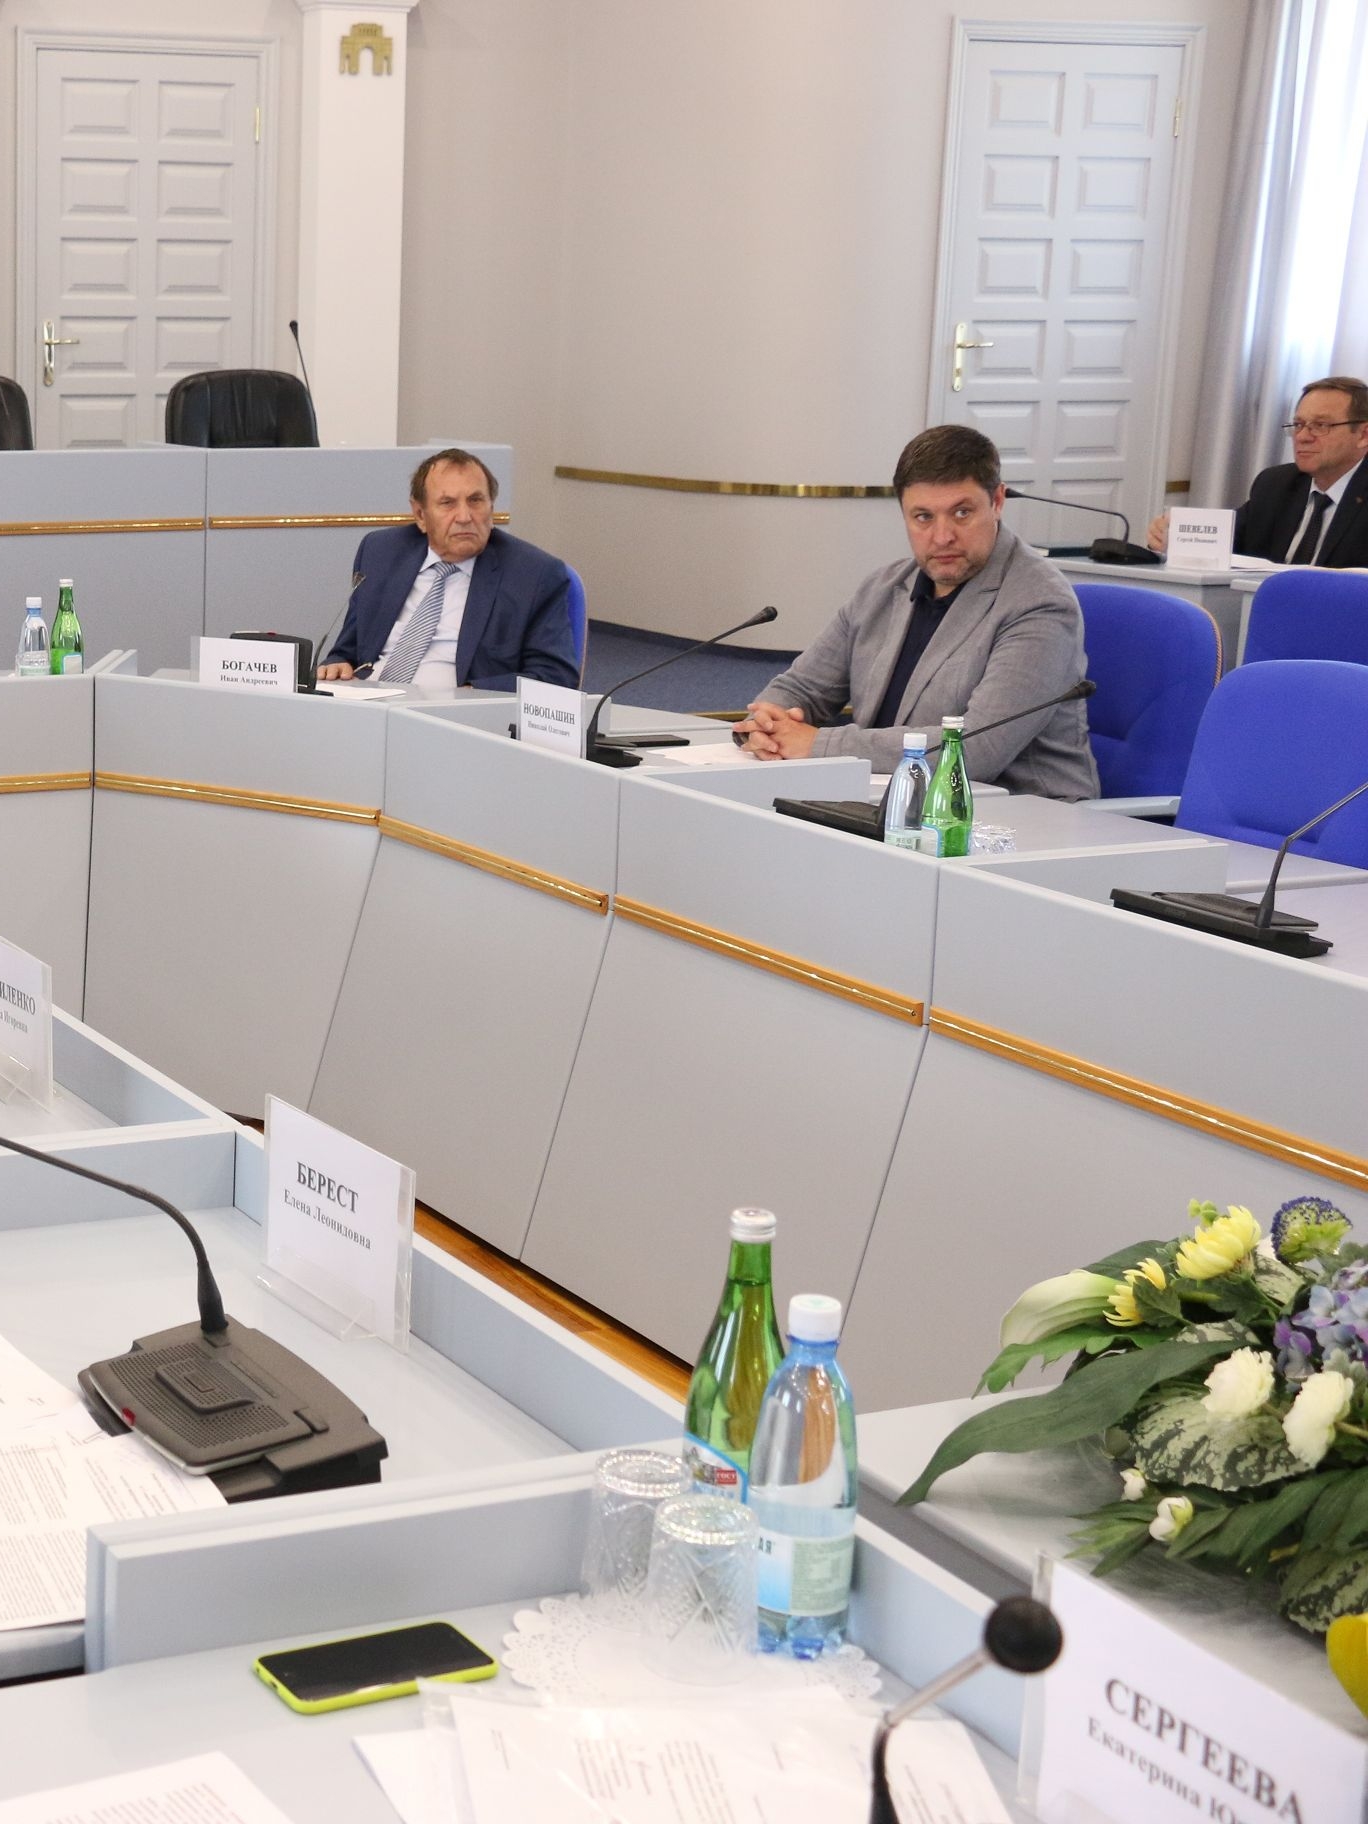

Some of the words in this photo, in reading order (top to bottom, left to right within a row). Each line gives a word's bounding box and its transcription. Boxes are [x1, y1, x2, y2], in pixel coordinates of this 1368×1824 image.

[220, 674, 239, 683] Иван
[240, 675, 278, 686] Андреевич
[222, 660, 278, 674] БОГАЧЕВ
[523, 702, 576, 725] НОВОПАШИН
[296, 1161, 359, 1214] БЕРЕСТ
[283, 1188, 311, 1217] Елена
[313, 1208, 372, 1250] Леонидовна
[1087, 1716, 1201, 1810] Екатерина
[1104, 1678, 1303, 1824] СЕРГЕЕВА
